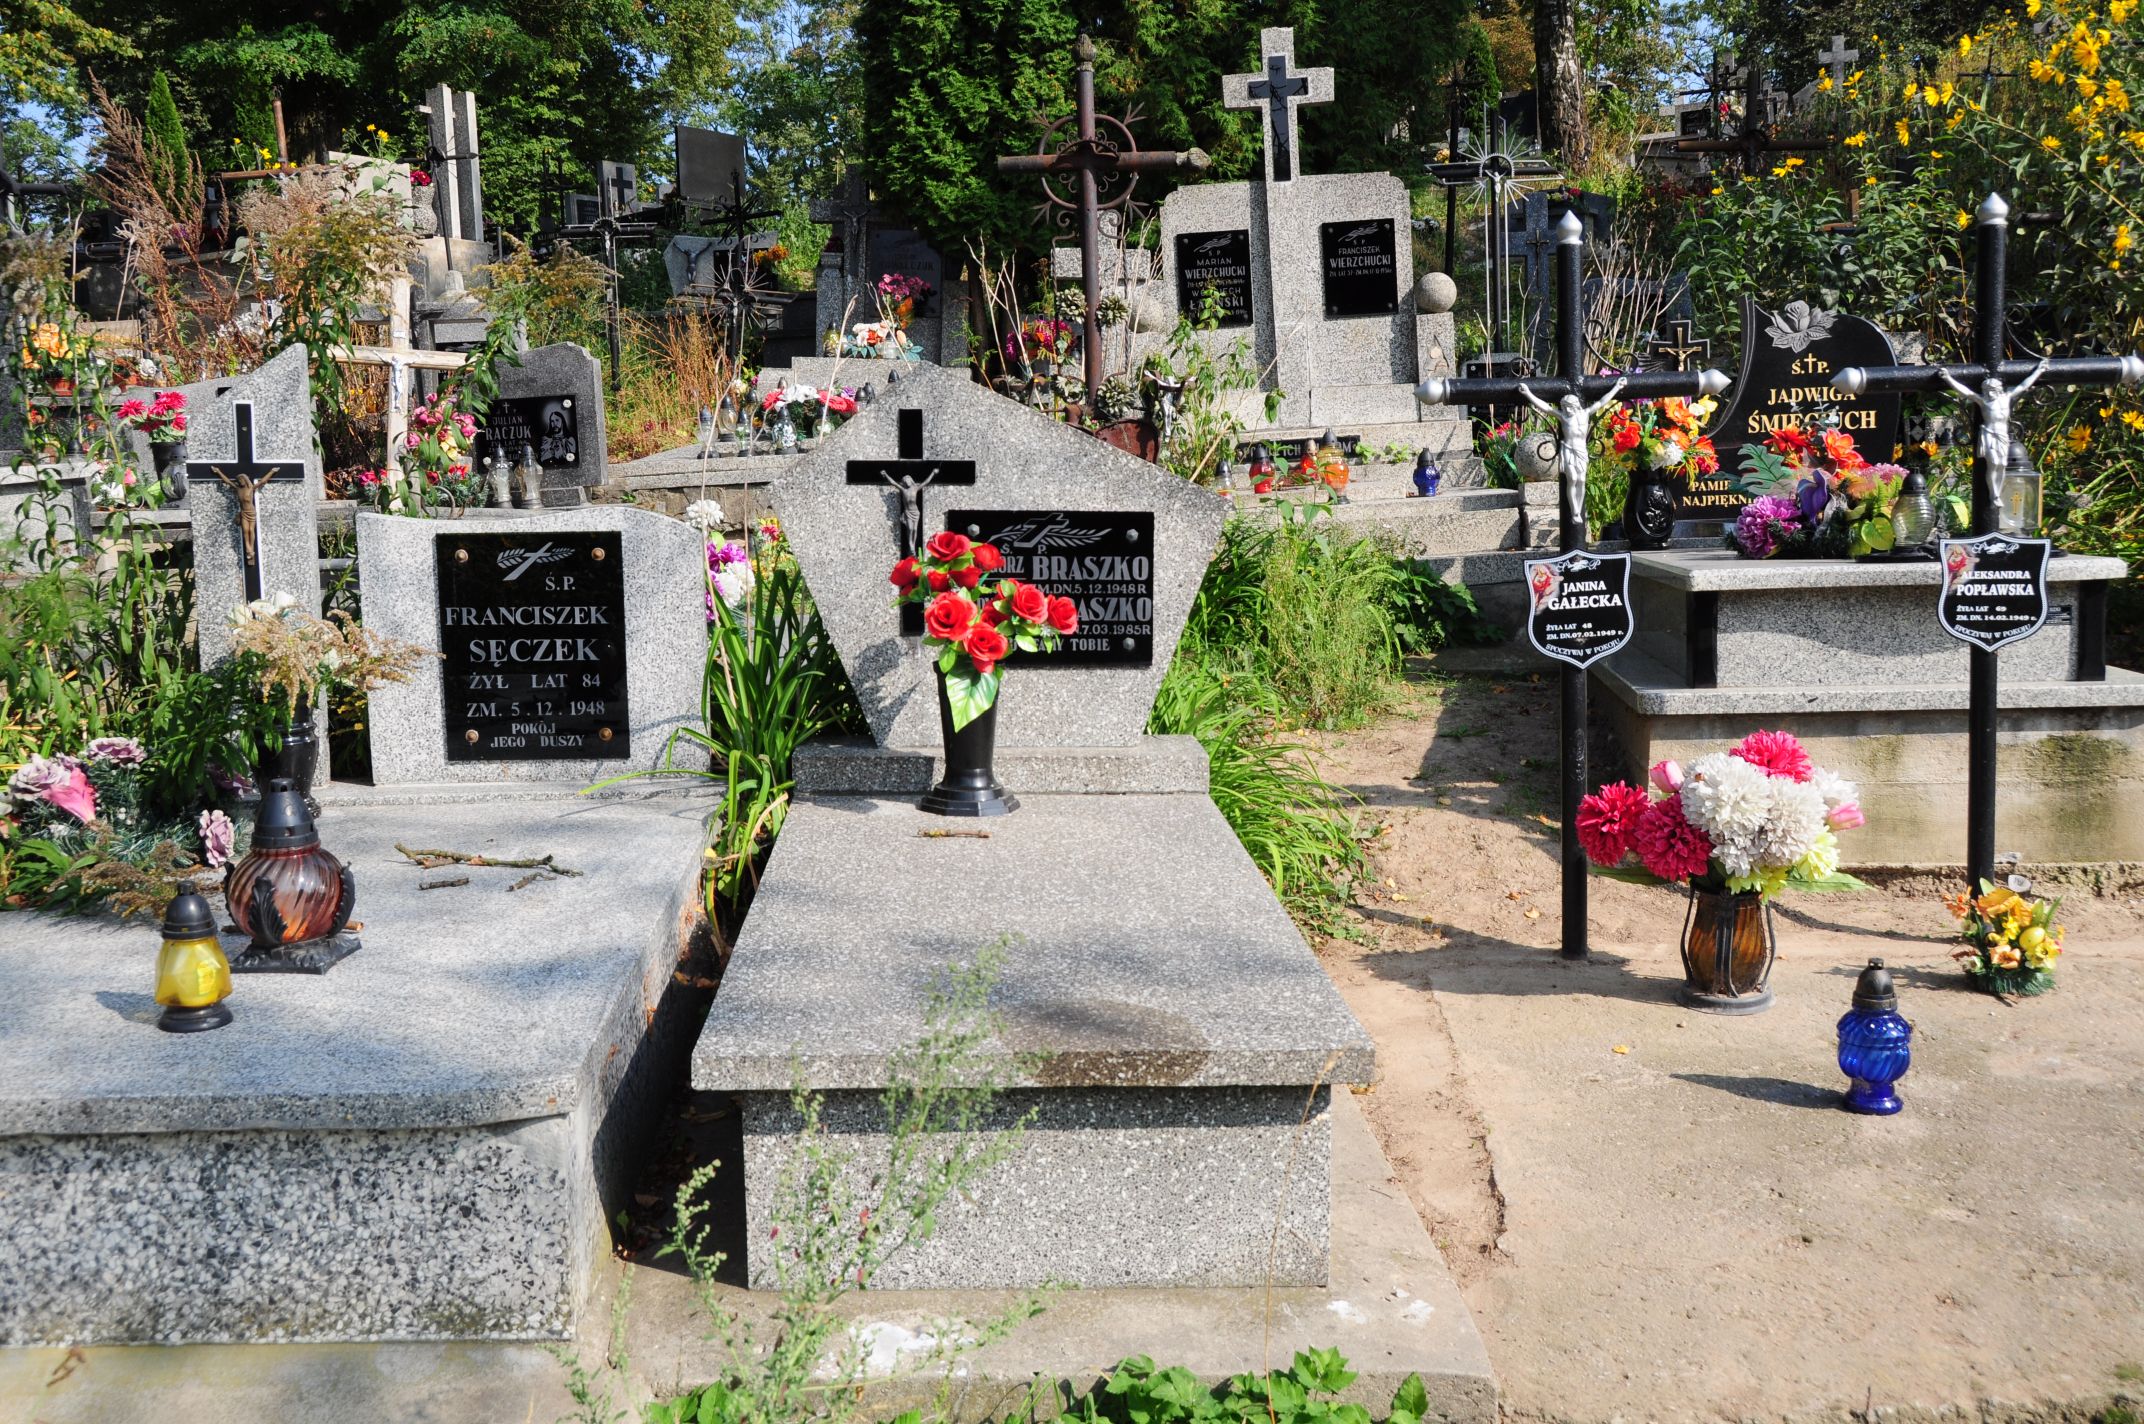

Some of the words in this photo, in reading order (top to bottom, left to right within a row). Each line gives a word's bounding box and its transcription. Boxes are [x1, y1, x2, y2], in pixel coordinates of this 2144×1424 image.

[1338, 246, 1380, 255] FRANCISZEK
[1197, 258, 1232, 266] MARIAN
[1330, 254, 1391, 269] WIERZCHUCKI
[1185, 265, 1246, 279] WIERZCHUCKI
[493, 416, 523, 426] JULIAN
[485, 425, 532, 441] RACZUK
[1032, 556, 1149, 581] BRASZKO
[1962, 570, 2031, 580] ALEKSANDRA
[1562, 580, 1607, 596] JANINA
[1956, 583, 2035, 596] POPŁAWSKA
[1548, 593, 1622, 611] GAŁECKA
[445, 606, 610, 626] FRANCISZEK
[1077, 597, 1152, 622] ASZKO
[1070, 638, 1110, 651] TOBIE
[469, 638, 600, 668] SĘCZEK
[469, 672, 509, 689] ŻYŁ
[531, 673, 568, 689] LAT
[582, 673, 601, 688] 84
[511, 721, 556, 735] POKÓJ
[490, 736, 526, 748] JEGO
[540, 734, 585, 747] DUSZY
